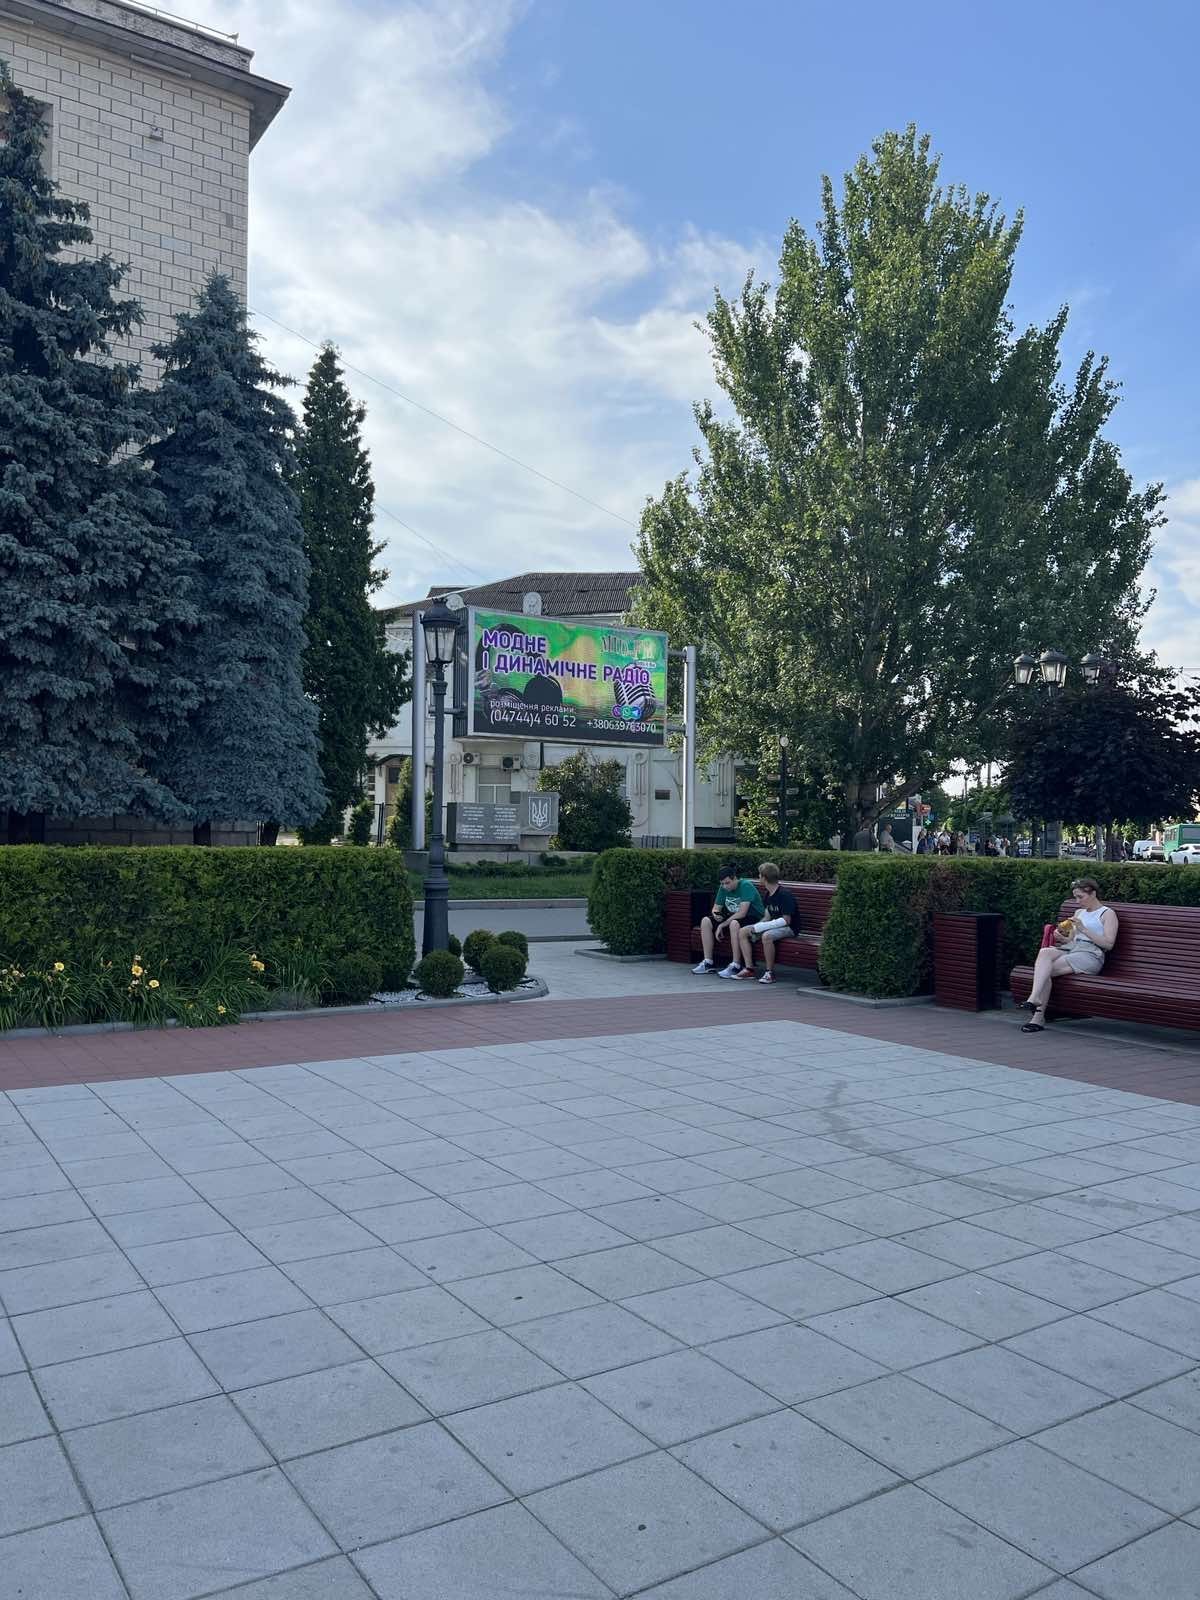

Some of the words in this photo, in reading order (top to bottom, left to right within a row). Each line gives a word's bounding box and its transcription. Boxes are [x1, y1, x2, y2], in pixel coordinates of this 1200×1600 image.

[483, 629, 547, 654] МОДНЕ
[483, 651, 489, 670] І
[494, 653, 597, 681] ДИНАМІЧНЕ
[603, 665, 650, 687] РАДІО
[490, 699, 539, 711] розміщення
[490, 709, 540, 727] (04744)4
[544, 713, 559, 726] 60
[562, 715, 576, 728] 52
